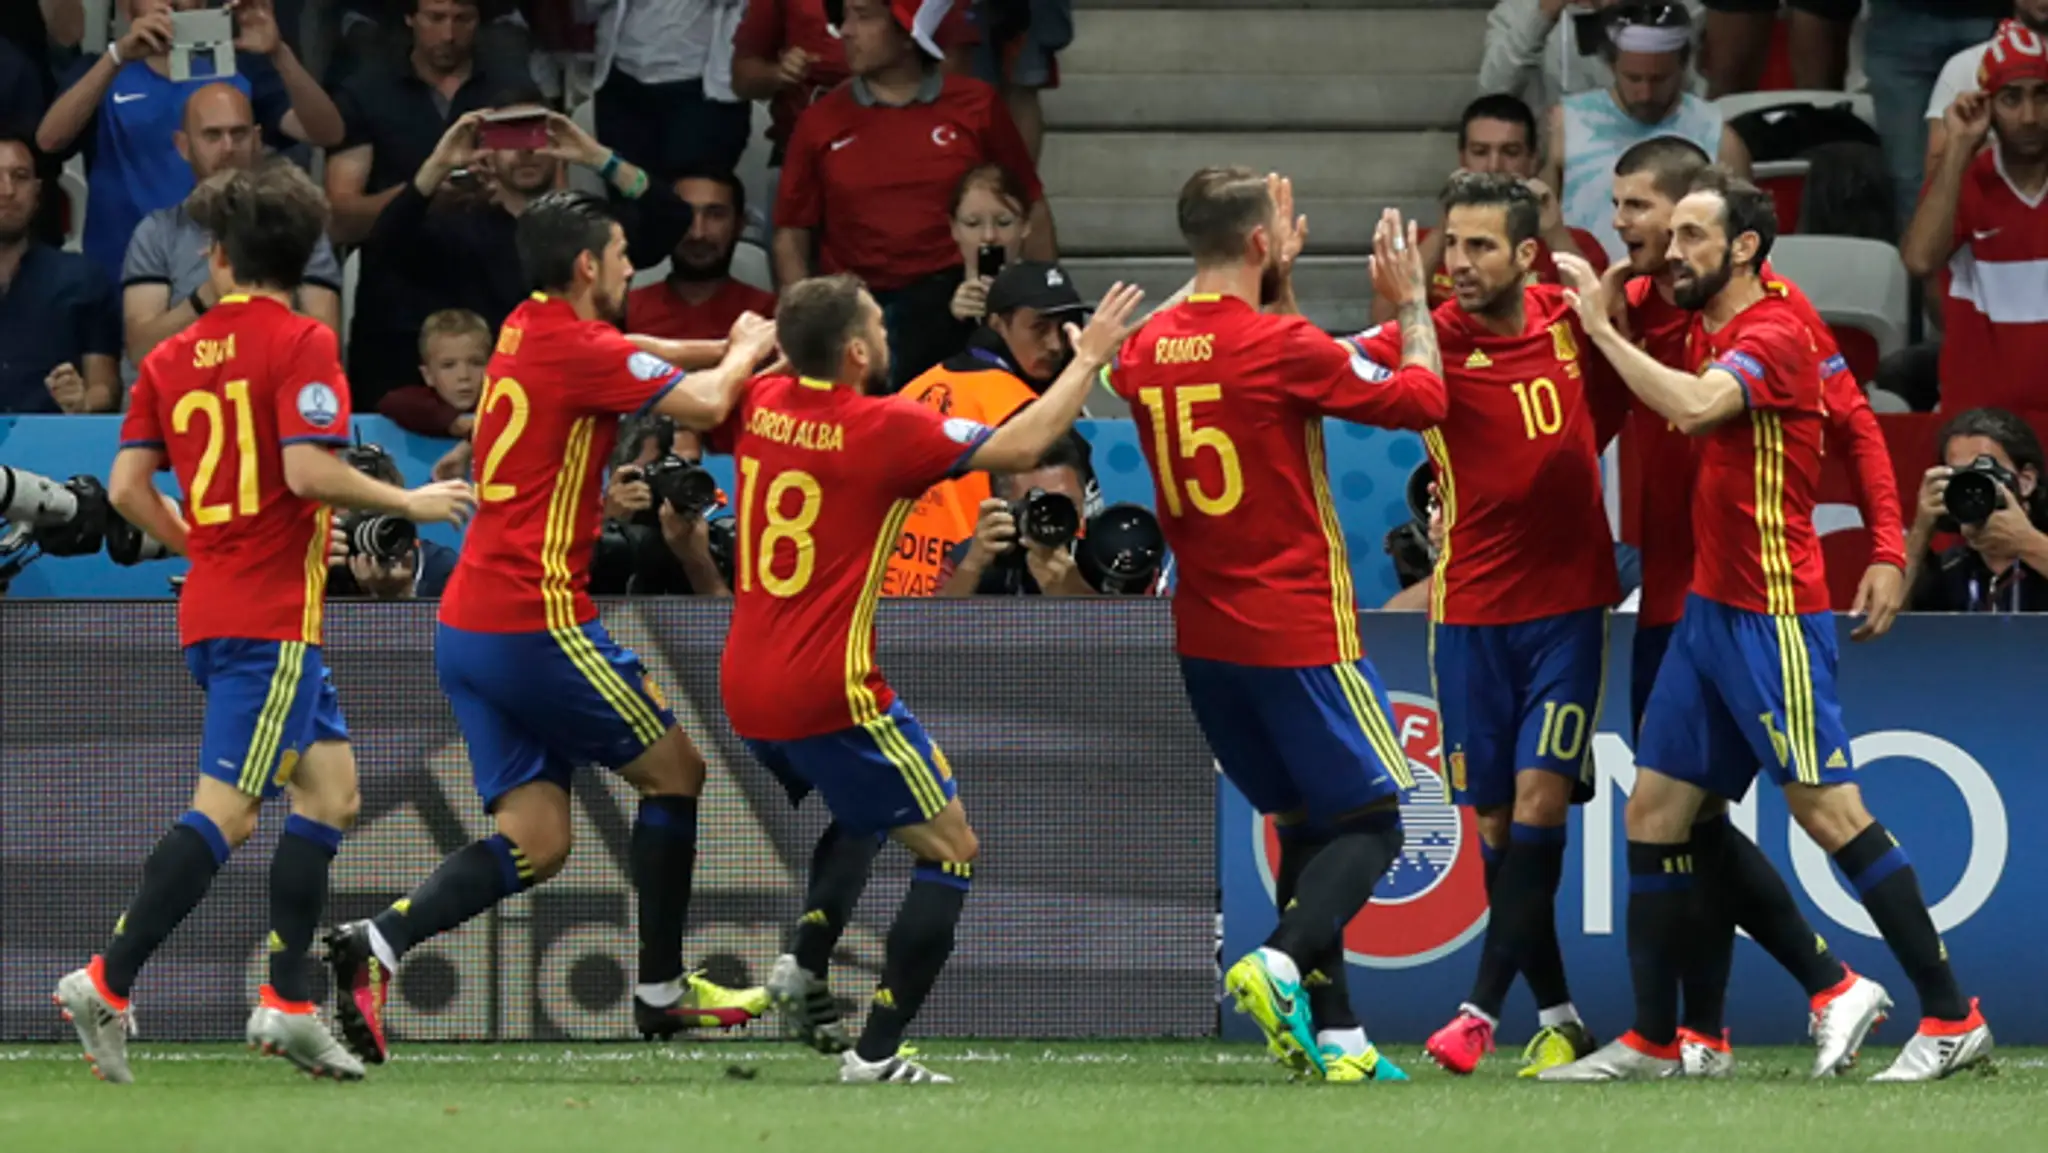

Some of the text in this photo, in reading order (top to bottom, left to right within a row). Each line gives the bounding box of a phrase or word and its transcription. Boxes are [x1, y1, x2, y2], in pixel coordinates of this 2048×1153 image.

[1155, 333, 1215, 364] RAMOS
[792, 419, 843, 451] ALBA
[1511, 377, 1563, 440] 10
[172, 378, 259, 525] 21
[1138, 383, 1244, 517] 15
[740, 455, 822, 597] 18
[1536, 701, 1586, 760] 10
